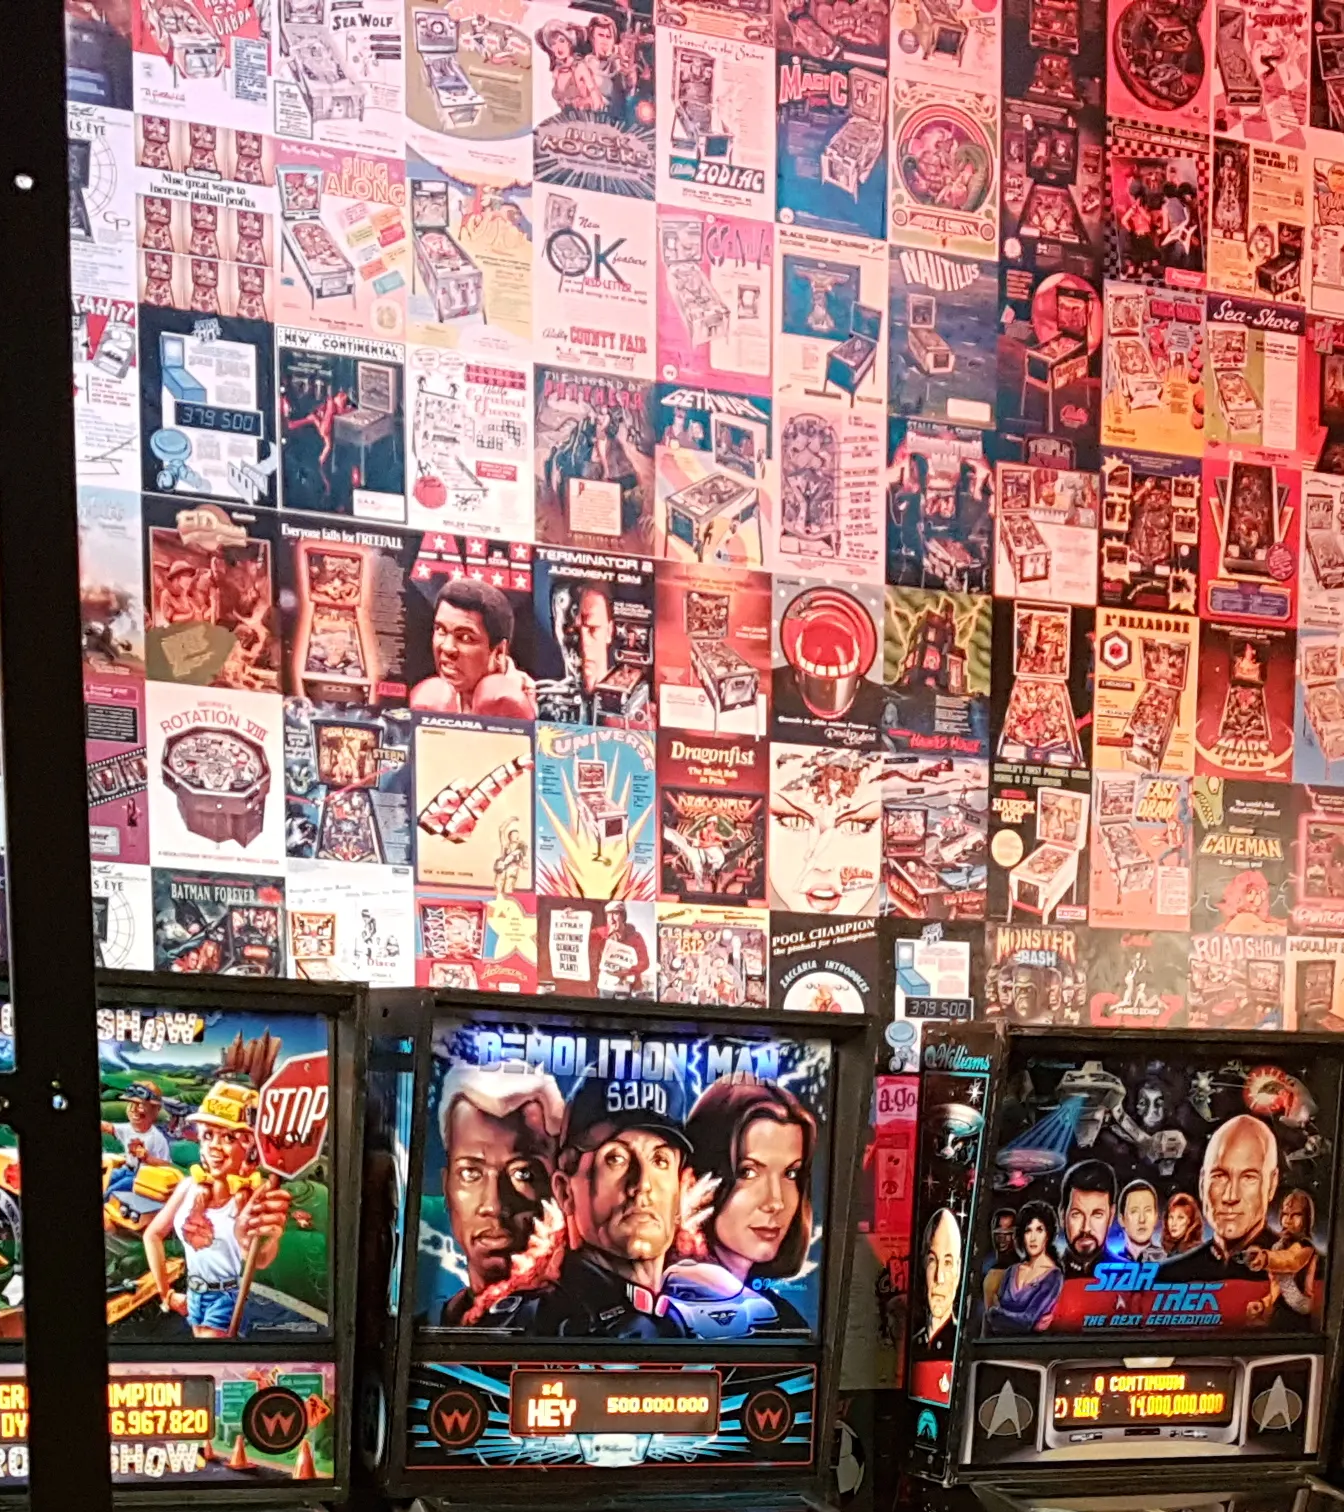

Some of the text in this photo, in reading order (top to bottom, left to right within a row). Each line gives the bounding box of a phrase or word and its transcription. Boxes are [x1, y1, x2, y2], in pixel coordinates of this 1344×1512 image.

[212, 4, 252, 35] DABRA
[332, 14, 394, 30] SEA WOLF
[779, 64, 849, 107] MAGIC
[565, 127, 632, 150] BUCK
[540, 138, 654, 170] ROGERS
[342, 157, 389, 181] SING
[695, 164, 764, 192] ZODIAC
[150, 182, 256, 209] increase pinball profits
[160, 173, 246, 195] Nine great ways to
[325, 172, 405, 206] ALONG
[578, 215, 601, 230] New
[546, 228, 628, 286] OK
[899, 250, 981, 292] NAUTILUS
[1213, 299, 1300, 333] Sea-Shore
[284, 333, 398, 357] NEW CONTINENTAL
[570, 326, 648, 354] COUNTY FAIR
[661, 387, 769, 420] GETAWAY
[181, 406, 254, 431] 379 500
[281, 523, 403, 549] Everyone falls for FREEFALL
[536, 548, 640, 571] TERMINATOR
[548, 566, 642, 585] JUDGMENT DAY
[160, 709, 240, 736] ROTATION
[245, 717, 270, 743] VIII
[420, 716, 483, 731] ZACCARIA
[555, 729, 655, 772] UNIVERSE
[671, 740, 756, 768] Dragonfist
[1144, 777, 1179, 799] FAST
[992, 797, 1036, 815] HAREM
[1137, 797, 1177, 822] DRAW
[1201, 834, 1284, 861] CAVEMAN
[171, 882, 256, 904] BATMAN FOREVER
[676, 939, 706, 954] 1812
[771, 919, 876, 948] POOL CHAMPION
[996, 926, 1078, 963] MONSTER
[787, 940, 815, 955] pinball
[1014, 950, 1056, 966] BASH
[367, 957, 397, 968] Disco
[779, 959, 871, 994] ZACCARIA INTRODUCES
[909, 1000, 967, 1017] 379 500
[97, 1008, 203, 1052] SHOW
[477, 1031, 780, 1085] DEMOLITION MAN
[938, 1044, 991, 1071] Williams
[261, 1085, 329, 1144] STOP
[1085, 1263, 1156, 1292] STAR
[1152, 1283, 1226, 1312] TREK
[1083, 1315, 1107, 1327] THE
[1110, 1314, 1144, 1326] NEXT
[527, 1396, 709, 1428] HEY 500.000.000
[111, 1443, 198, 1477] SHOW
